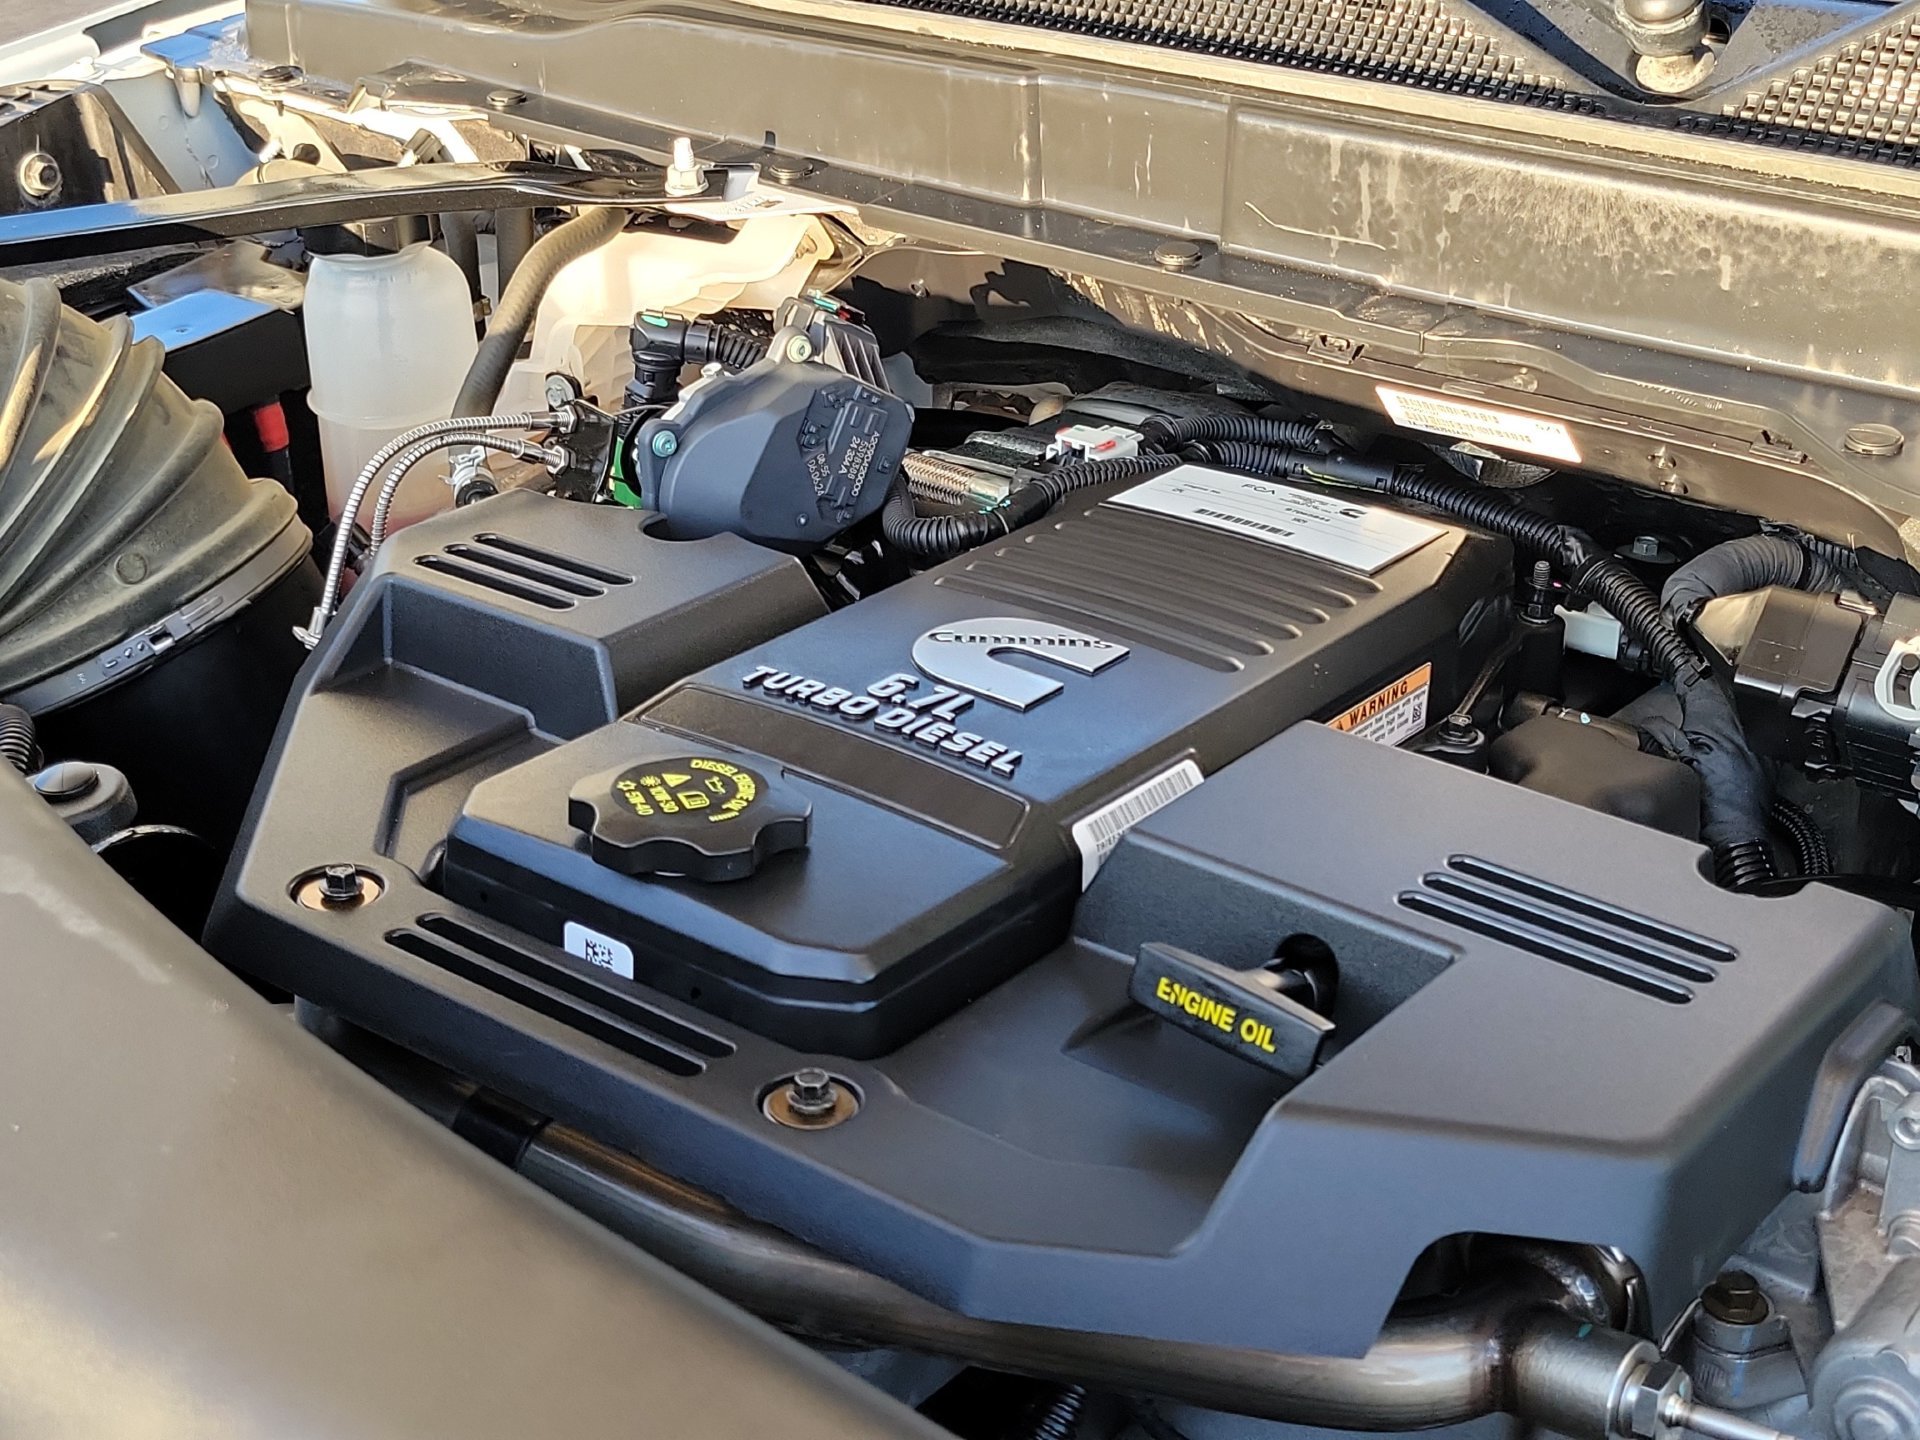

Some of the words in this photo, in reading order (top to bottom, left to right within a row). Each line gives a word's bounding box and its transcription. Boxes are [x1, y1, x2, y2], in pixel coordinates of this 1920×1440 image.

[929, 630, 1112, 649] Cummins
[742, 665, 880, 717] TURBO
[874, 706, 1023, 775] DIESEL
[866, 672, 975, 721] 6.7L
[1349, 681, 1408, 726] WARNING
[690, 758, 738, 777] DIESEL
[721, 793, 748, 812] OIL
[1156, 976, 1238, 1033] ENGINE
[1239, 1017, 1277, 1054] OIL
